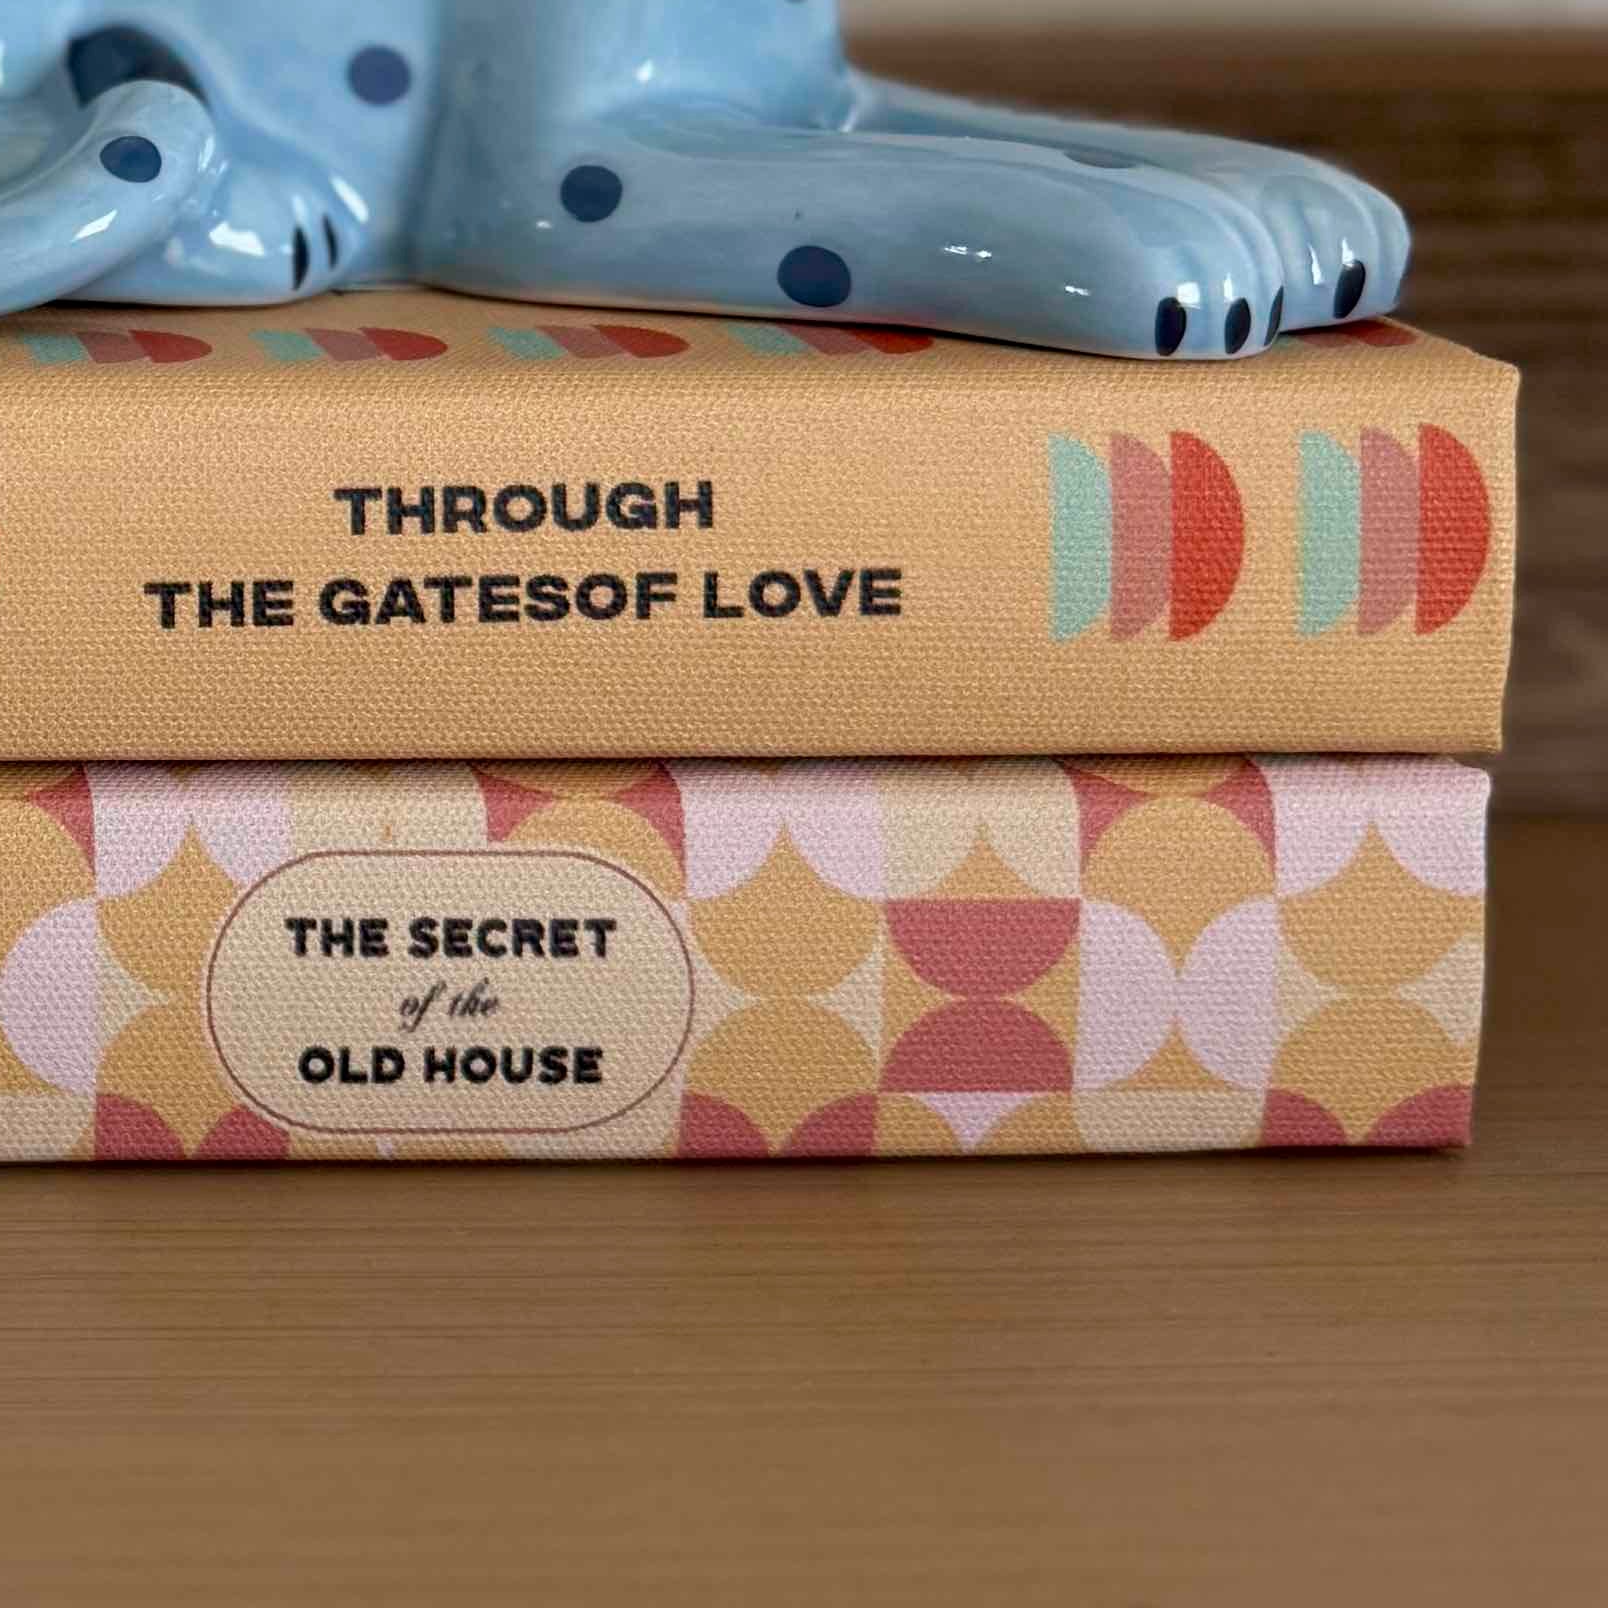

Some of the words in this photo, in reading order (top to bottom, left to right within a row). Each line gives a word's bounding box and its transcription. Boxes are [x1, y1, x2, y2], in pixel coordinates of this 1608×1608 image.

[334, 480, 714, 536] THROUGH
[144, 579, 295, 629] THE
[319, 572, 678, 625] GATESOF
[704, 568, 902, 618] LOVE
[285, 917, 390, 958] THE
[407, 917, 617, 959] SECRET
[399, 980, 446, 1033] of
[447, 977, 499, 1018] the
[298, 1046, 405, 1085] OLD
[424, 1046, 604, 1086] HOUSE
